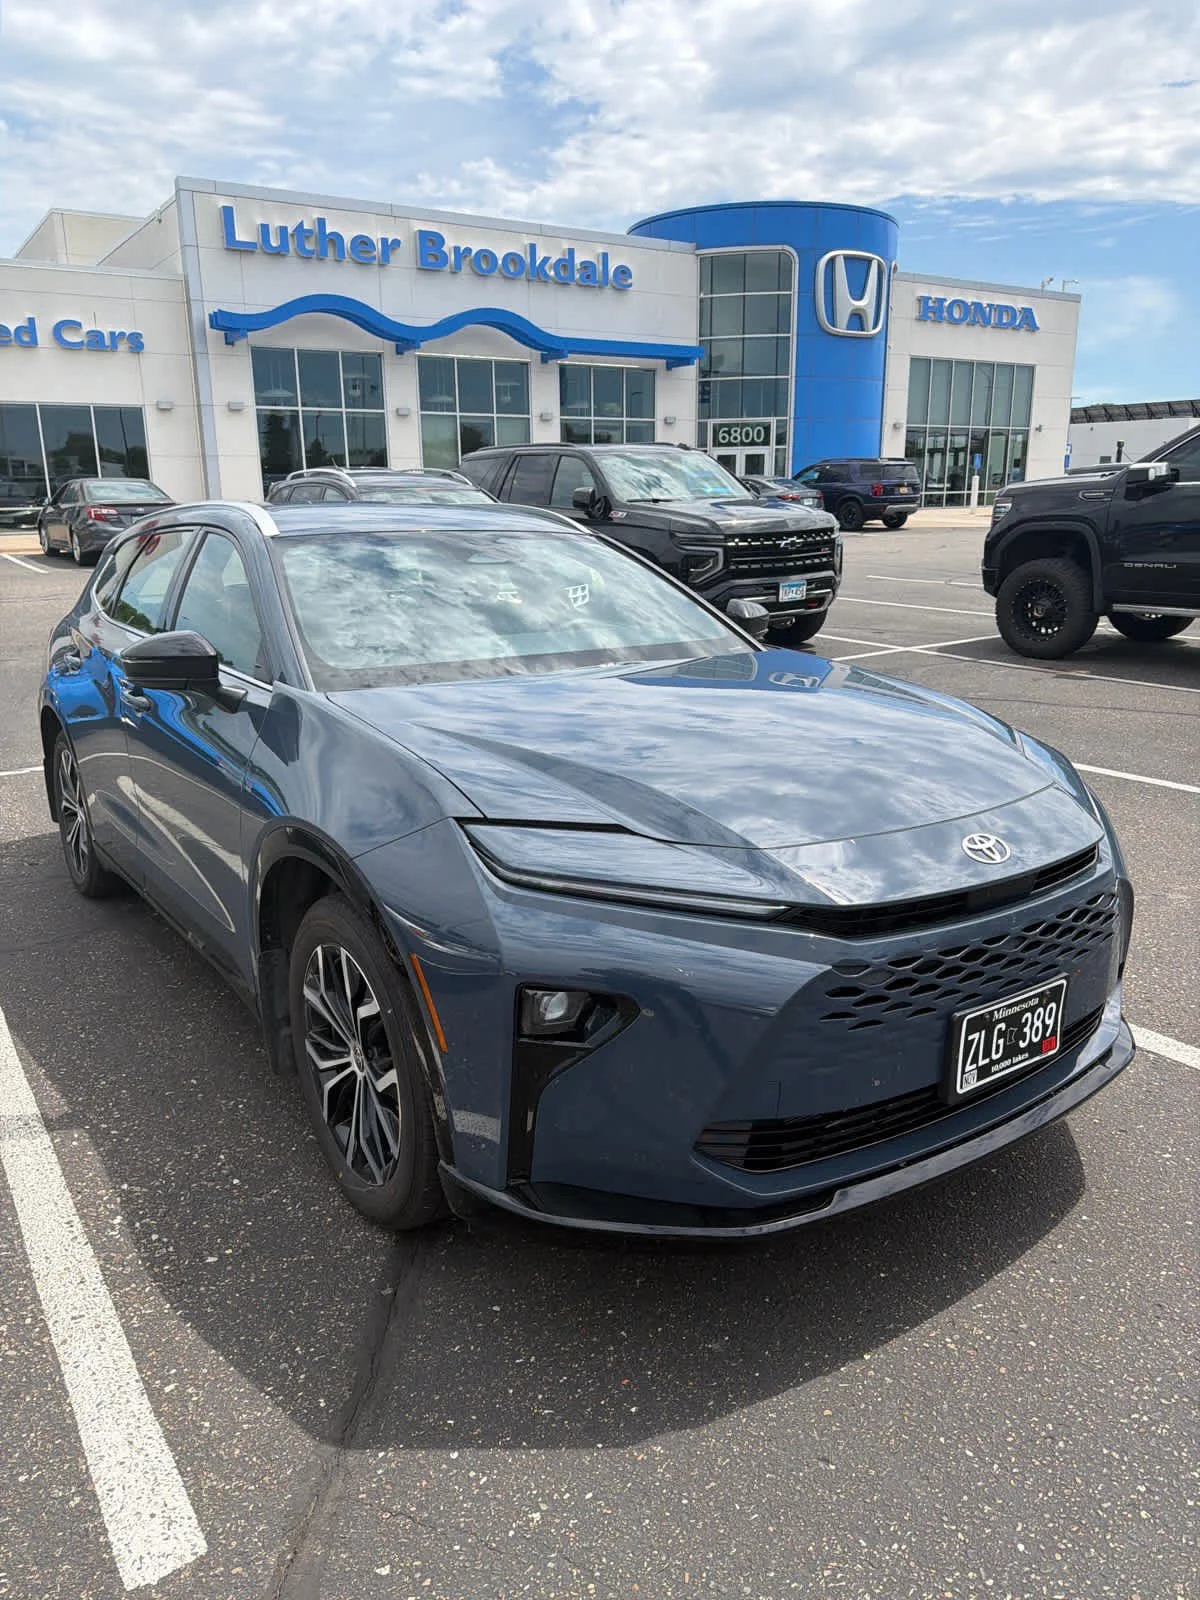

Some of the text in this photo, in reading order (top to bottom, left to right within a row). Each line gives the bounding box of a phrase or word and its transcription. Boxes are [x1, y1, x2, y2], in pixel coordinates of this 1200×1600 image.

[219, 204, 633, 290] Luther Brookdale
[915, 295, 1040, 332] HONDA
[52, 319, 145, 353] Cars
[718, 426, 765, 443] 6800
[992, 997, 1040, 1022] Minnesota
[965, 1002, 1057, 1072] ZLG 389
